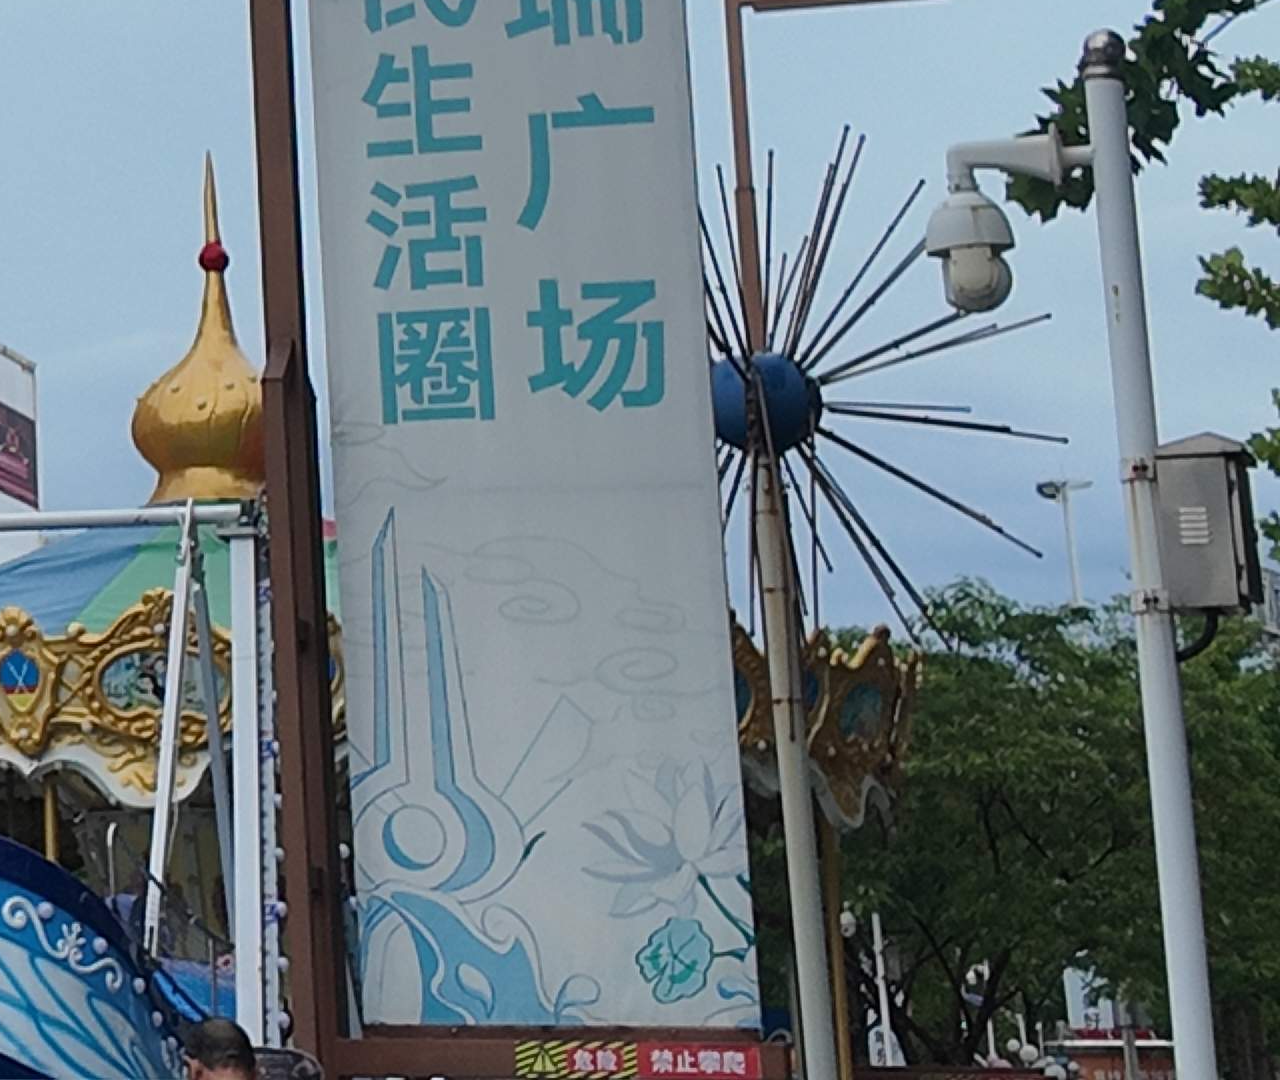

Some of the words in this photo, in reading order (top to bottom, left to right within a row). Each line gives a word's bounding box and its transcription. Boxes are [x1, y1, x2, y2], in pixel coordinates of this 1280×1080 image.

[573, 1048, 617, 1072] 危险
[650, 1048, 746, 1075] 禁止攀爬
